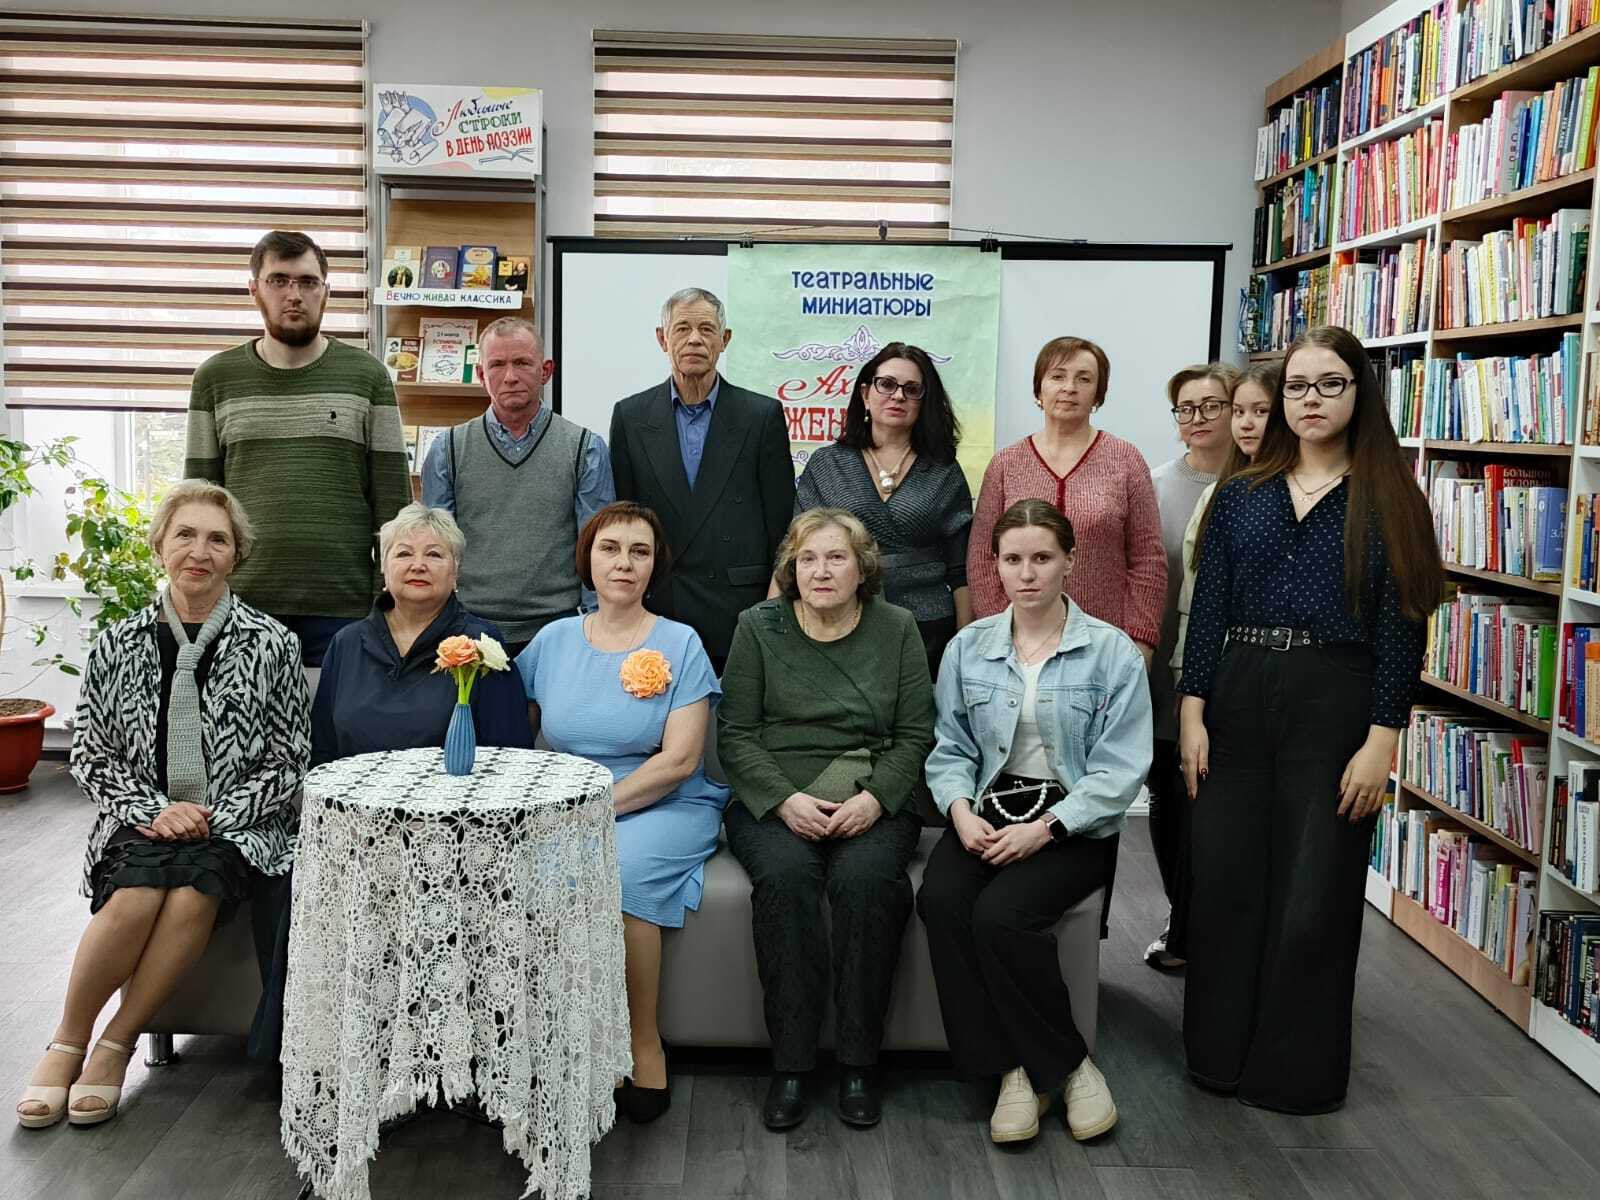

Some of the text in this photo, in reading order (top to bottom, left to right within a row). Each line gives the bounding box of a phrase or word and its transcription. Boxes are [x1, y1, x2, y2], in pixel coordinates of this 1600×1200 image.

[458, 111, 522, 134] СТРОКИ
[446, 126, 532, 157] В ДЕНЬ ПОЭЗИИ
[386, 290, 512, 304] ВЕЧНО ЖИВАЯ КЛАССИКА
[784, 406, 848, 441] ЖЕН
